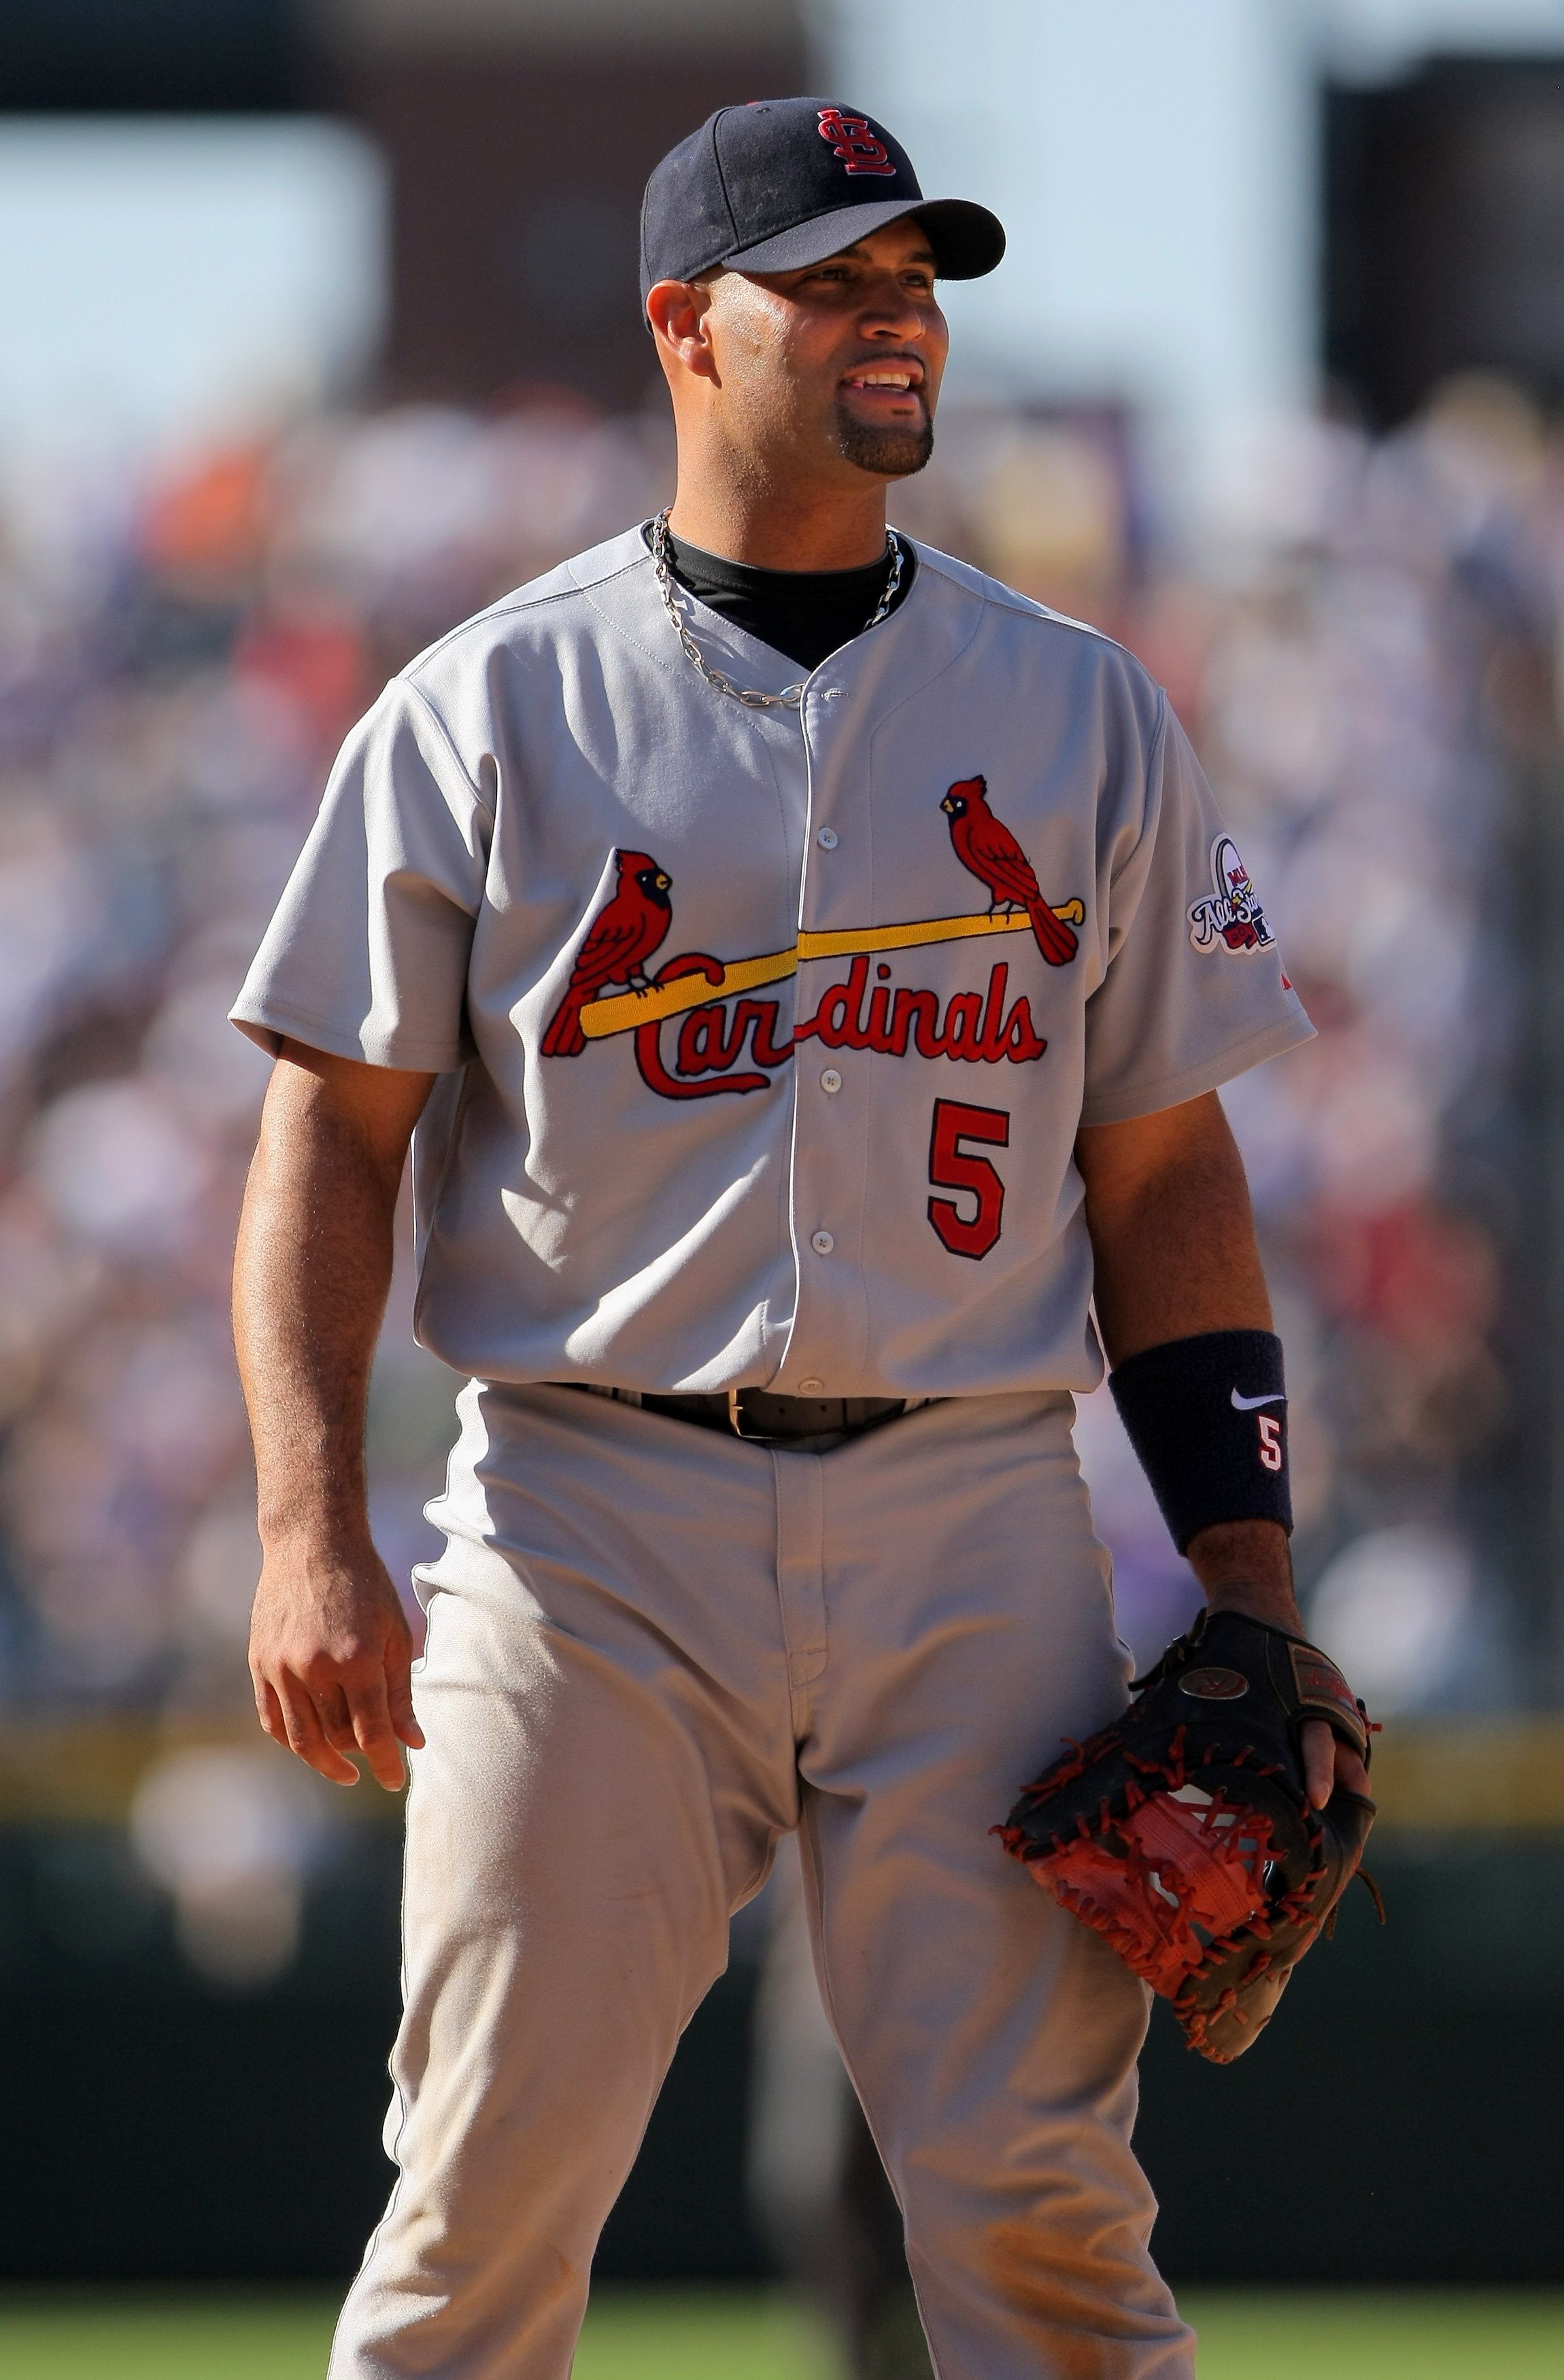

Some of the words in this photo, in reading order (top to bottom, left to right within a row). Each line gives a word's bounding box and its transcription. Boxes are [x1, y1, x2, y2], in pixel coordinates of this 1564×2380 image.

[634, 953, 1048, 1100] Cardinals
[928, 1098, 1010, 1261] 5
[1258, 1414, 1282, 1472] 5
